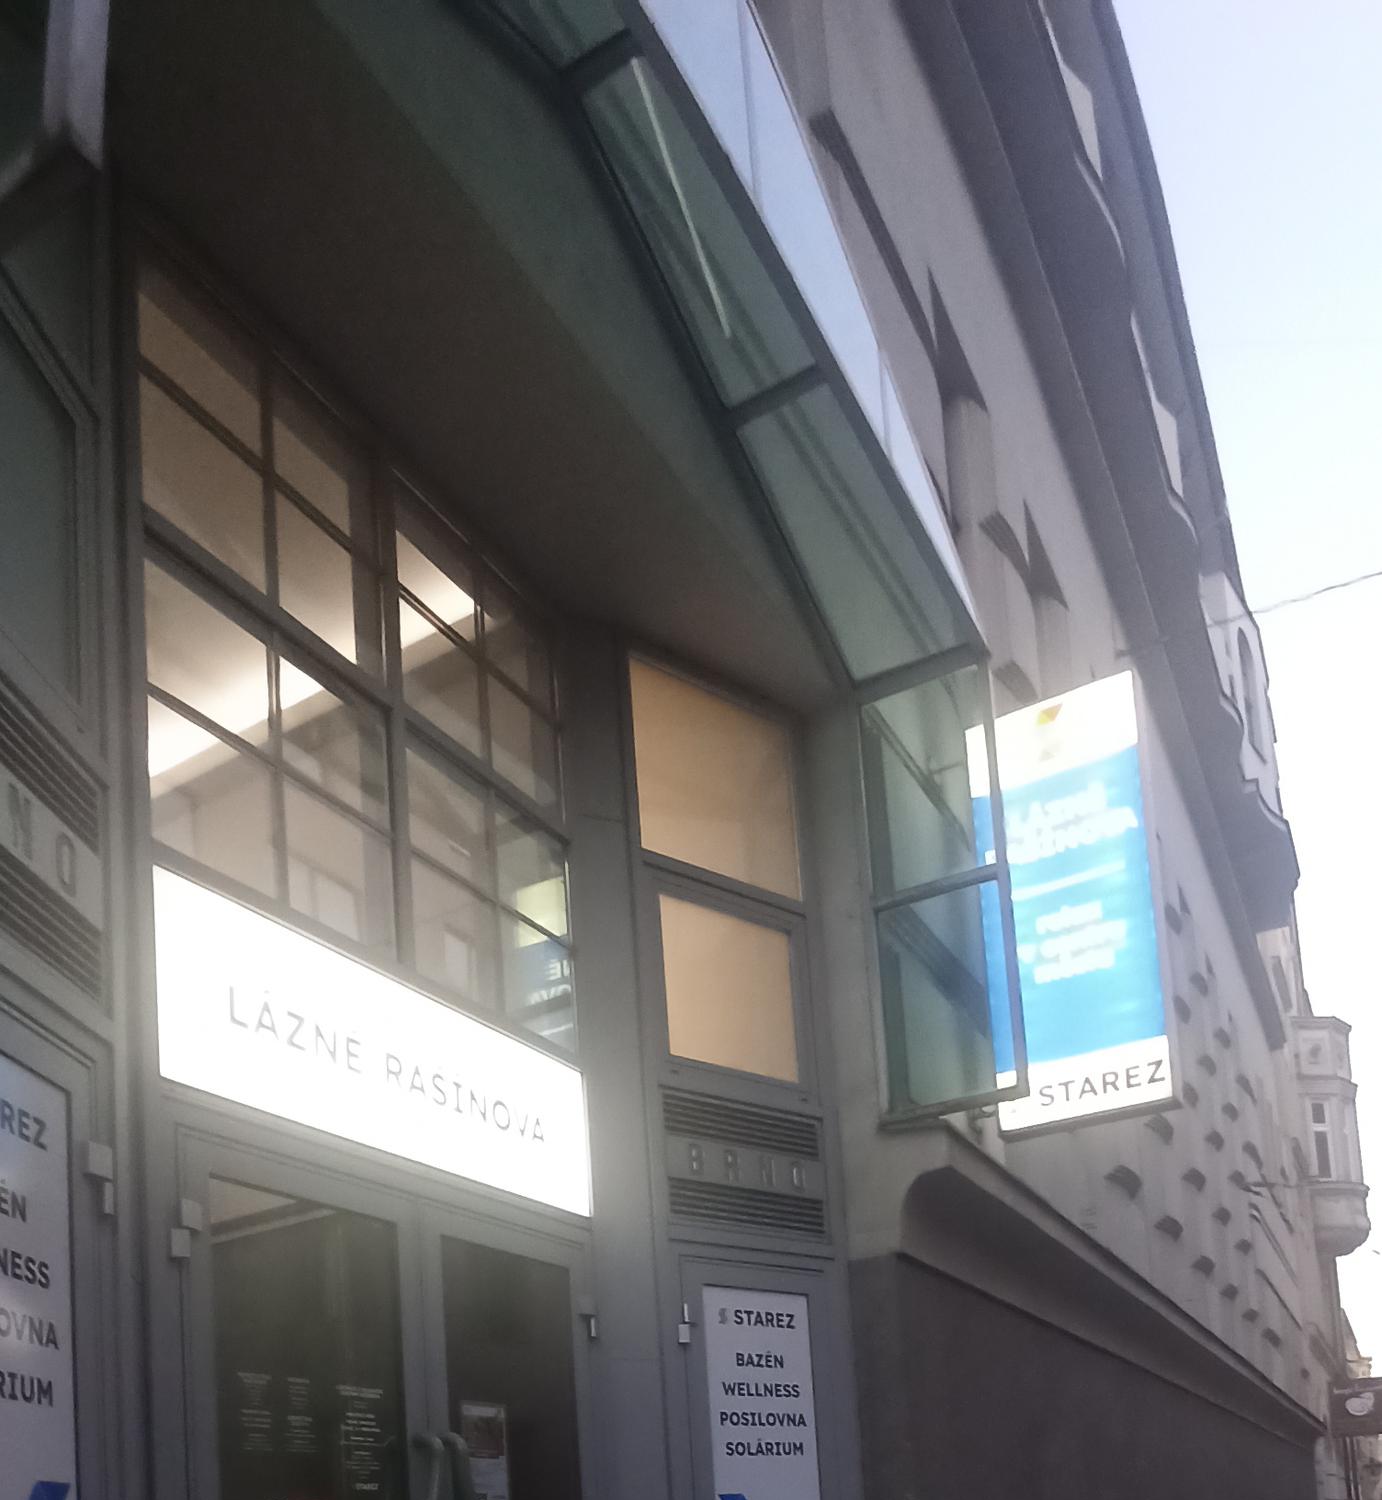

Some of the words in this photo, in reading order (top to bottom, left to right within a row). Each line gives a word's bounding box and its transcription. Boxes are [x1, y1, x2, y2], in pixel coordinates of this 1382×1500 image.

[1039, 1059, 1166, 1107] STAREZ
[688, 1143, 806, 1194] BRNO
[734, 1309, 796, 1330] STAREZ
[735, 1351, 785, 1369] BAZÉN
[722, 1381, 800, 1399] WELLNESS
[720, 1411, 808, 1428] POSILOVNA
[725, 1438, 804, 1457] SOLÁRIUM
